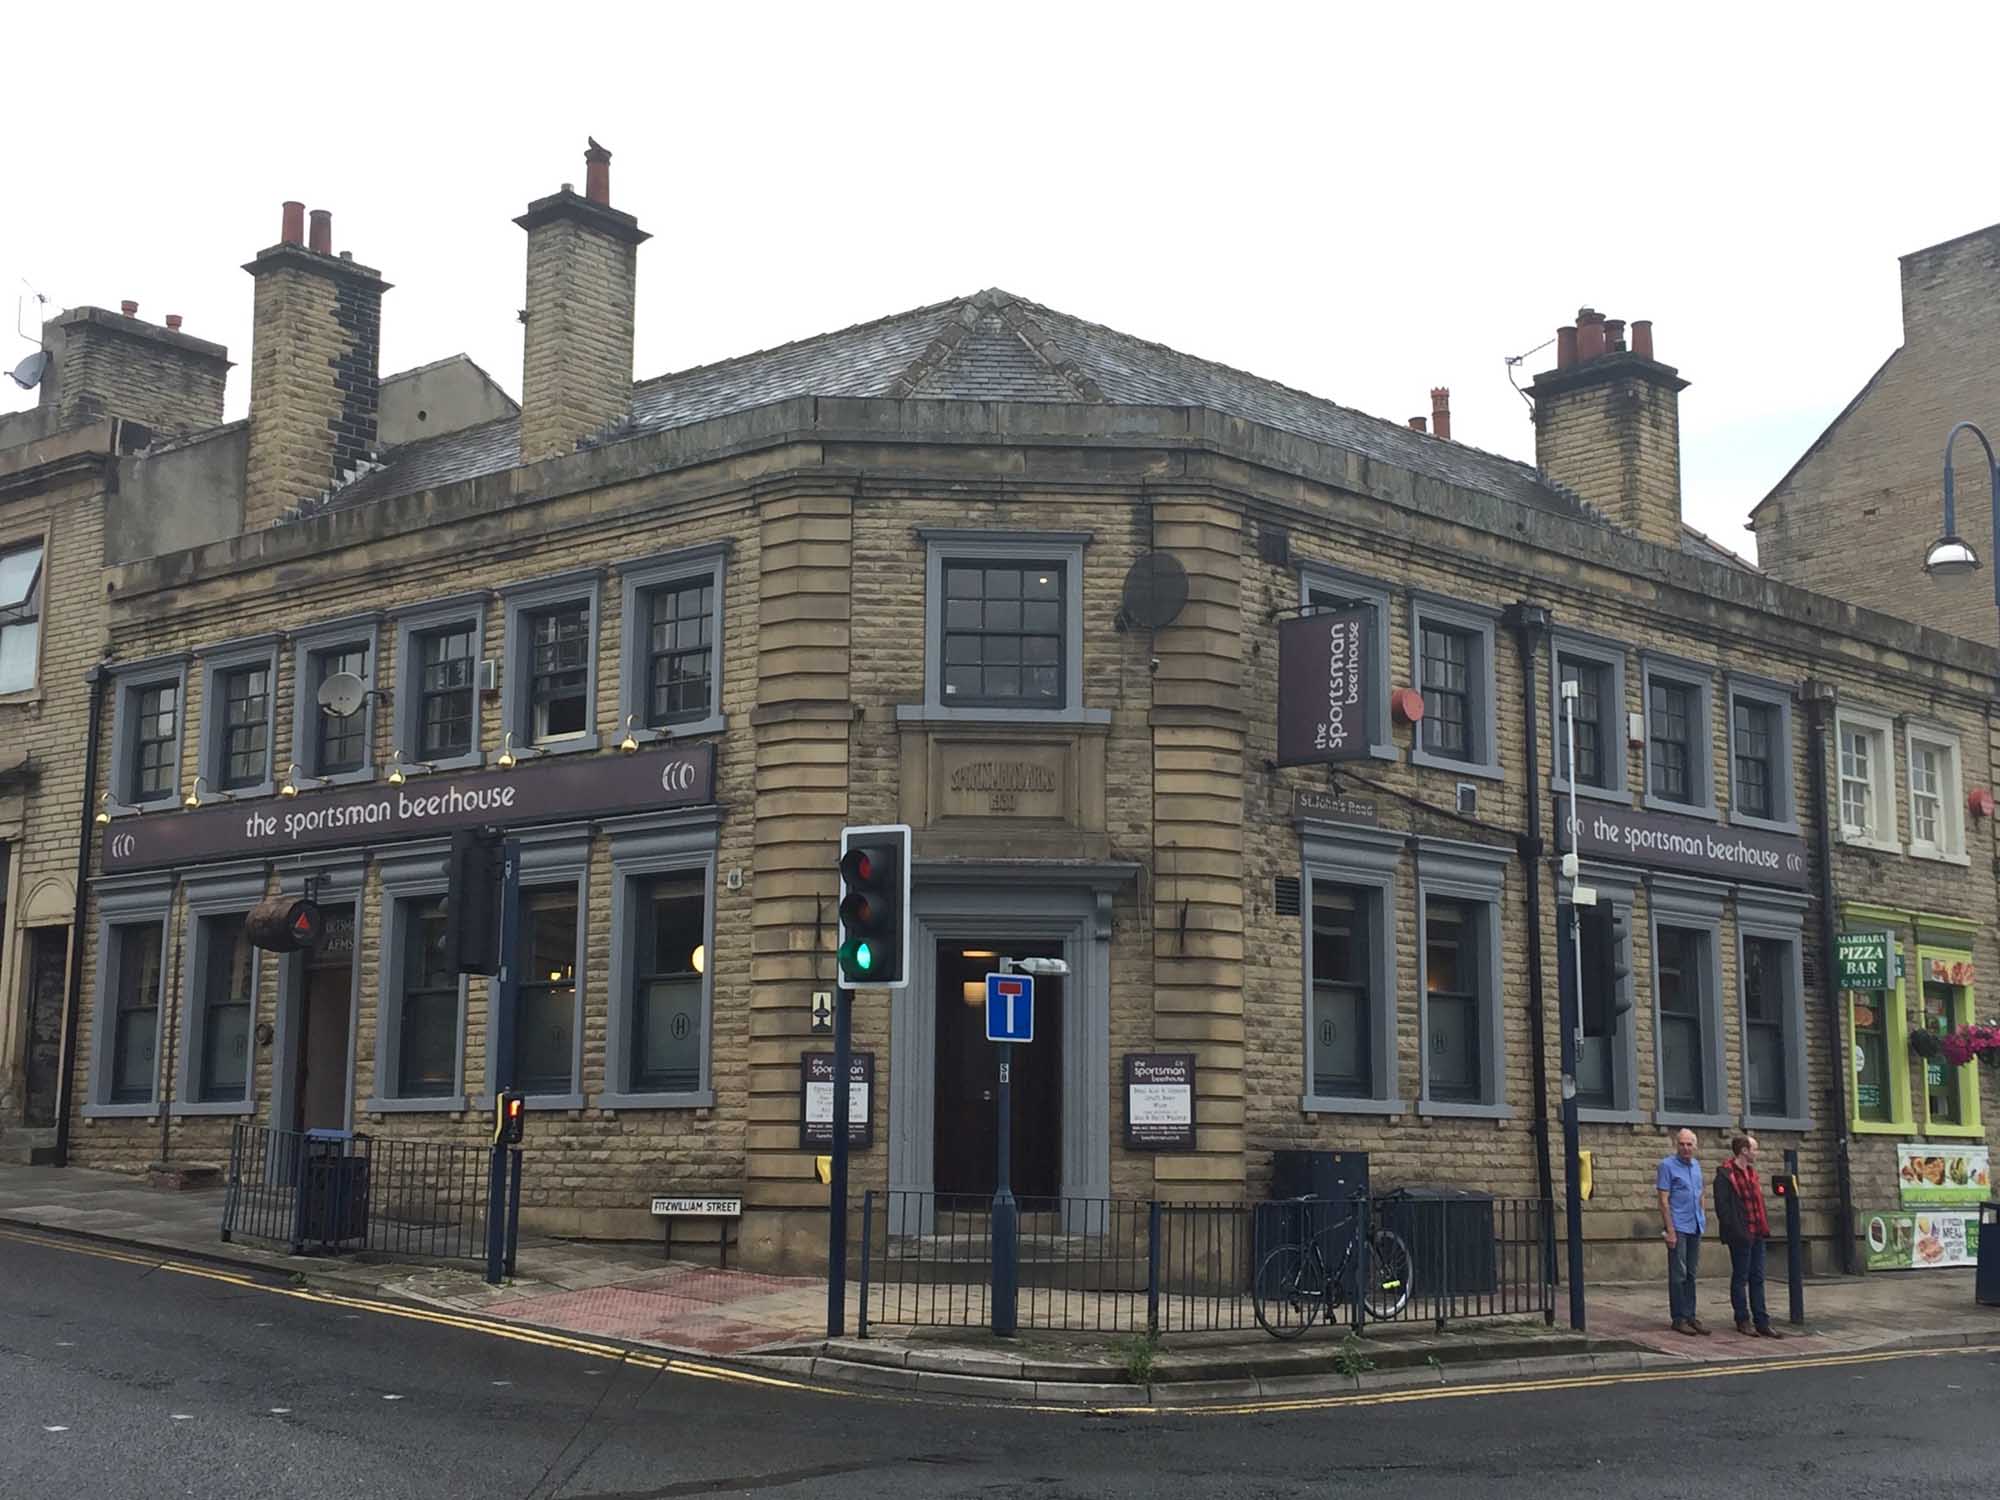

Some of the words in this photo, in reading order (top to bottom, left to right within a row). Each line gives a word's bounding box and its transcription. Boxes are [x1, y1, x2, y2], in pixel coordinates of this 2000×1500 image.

[1345, 621, 1359, 704] beerhouse
[1328, 623, 1348, 748] sportsman
[1314, 723, 1327, 749] the
[245, 812, 276, 838] the
[284, 801, 391, 839] sportsman
[399, 783, 516, 819] beerhouse
[1593, 815, 1619, 843] the
[1625, 826, 1704, 853] sportsman
[1706, 834, 1780, 869] beerhouse
[1839, 946, 1884, 960] PIZZA
[1846, 961, 1878, 975] BAR
[812, 1066, 864, 1075] sporan
[1134, 1067, 1186, 1077] sportsman
[655, 1202, 703, 1211] FITZWILLIAM
[706, 1202, 737, 1212] STREET
